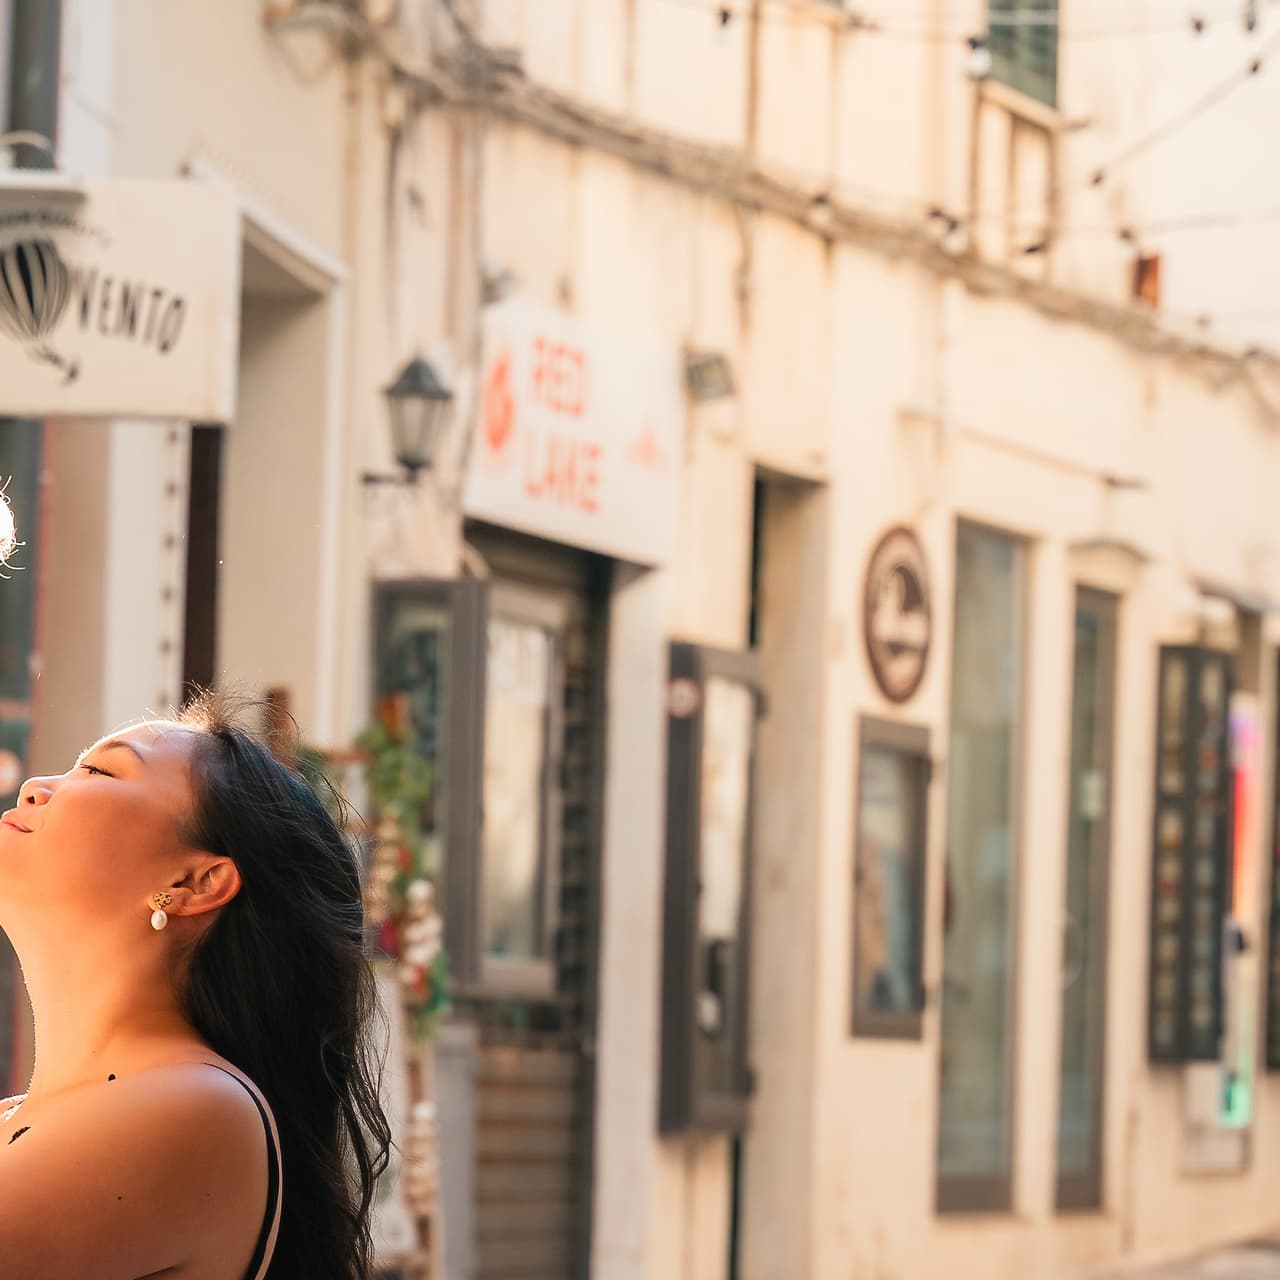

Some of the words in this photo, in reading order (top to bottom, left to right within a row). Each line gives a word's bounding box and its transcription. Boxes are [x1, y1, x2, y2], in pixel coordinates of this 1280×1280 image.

[71, 266, 187, 354] VENTO
[532, 335, 590, 418] RED
[523, 428, 601, 516] LAKE
